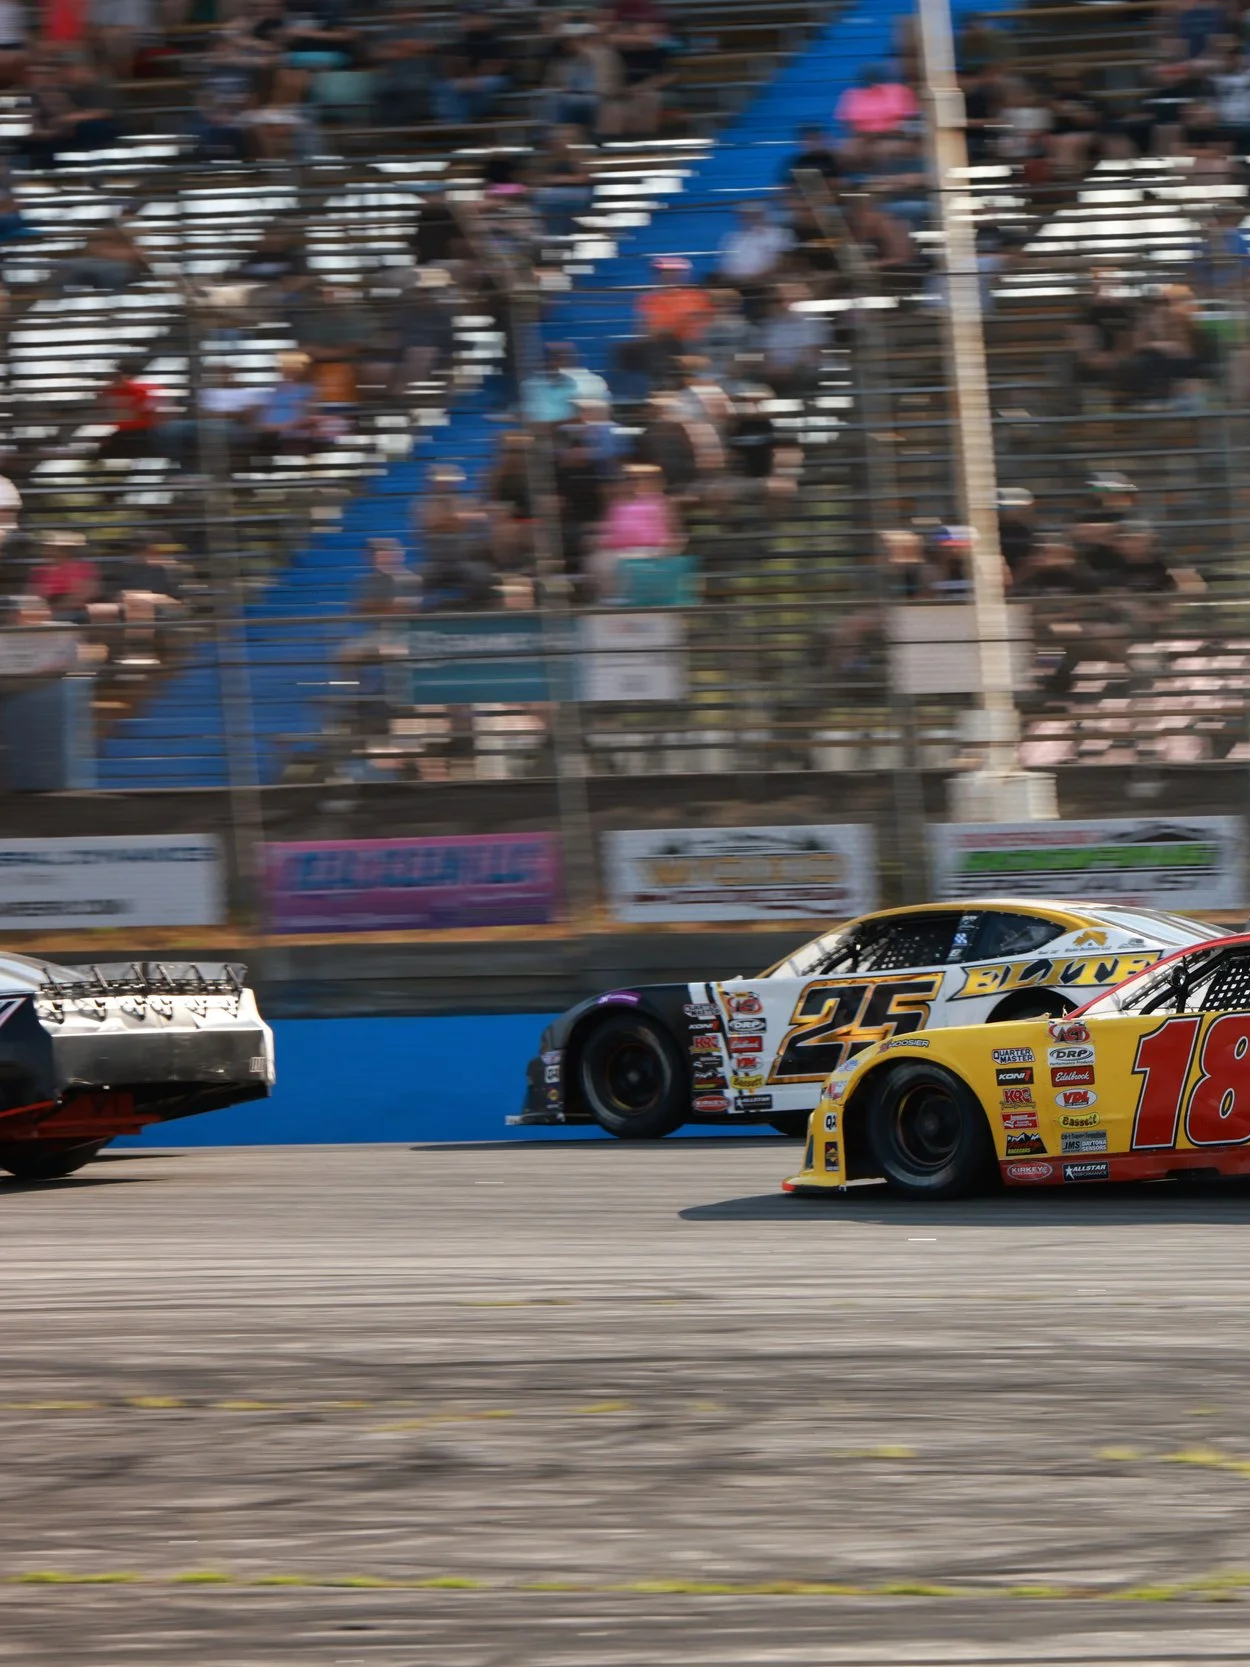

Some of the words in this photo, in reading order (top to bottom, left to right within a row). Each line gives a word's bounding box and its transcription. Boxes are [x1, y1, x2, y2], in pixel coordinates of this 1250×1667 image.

[960, 952, 1160, 995] ELITE
[767, 971, 945, 1083] 25
[888, 1039, 930, 1048] HOOSIER
[993, 1049, 1031, 1059] QUARTER
[1056, 1049, 1088, 1059] DRP
[1000, 1055, 1033, 1064] MASTER
[998, 1072, 1026, 1080] KONI
[1055, 1071, 1090, 1082] Edelbrock
[1073, 1164, 1106, 1172] ALLSTAR
